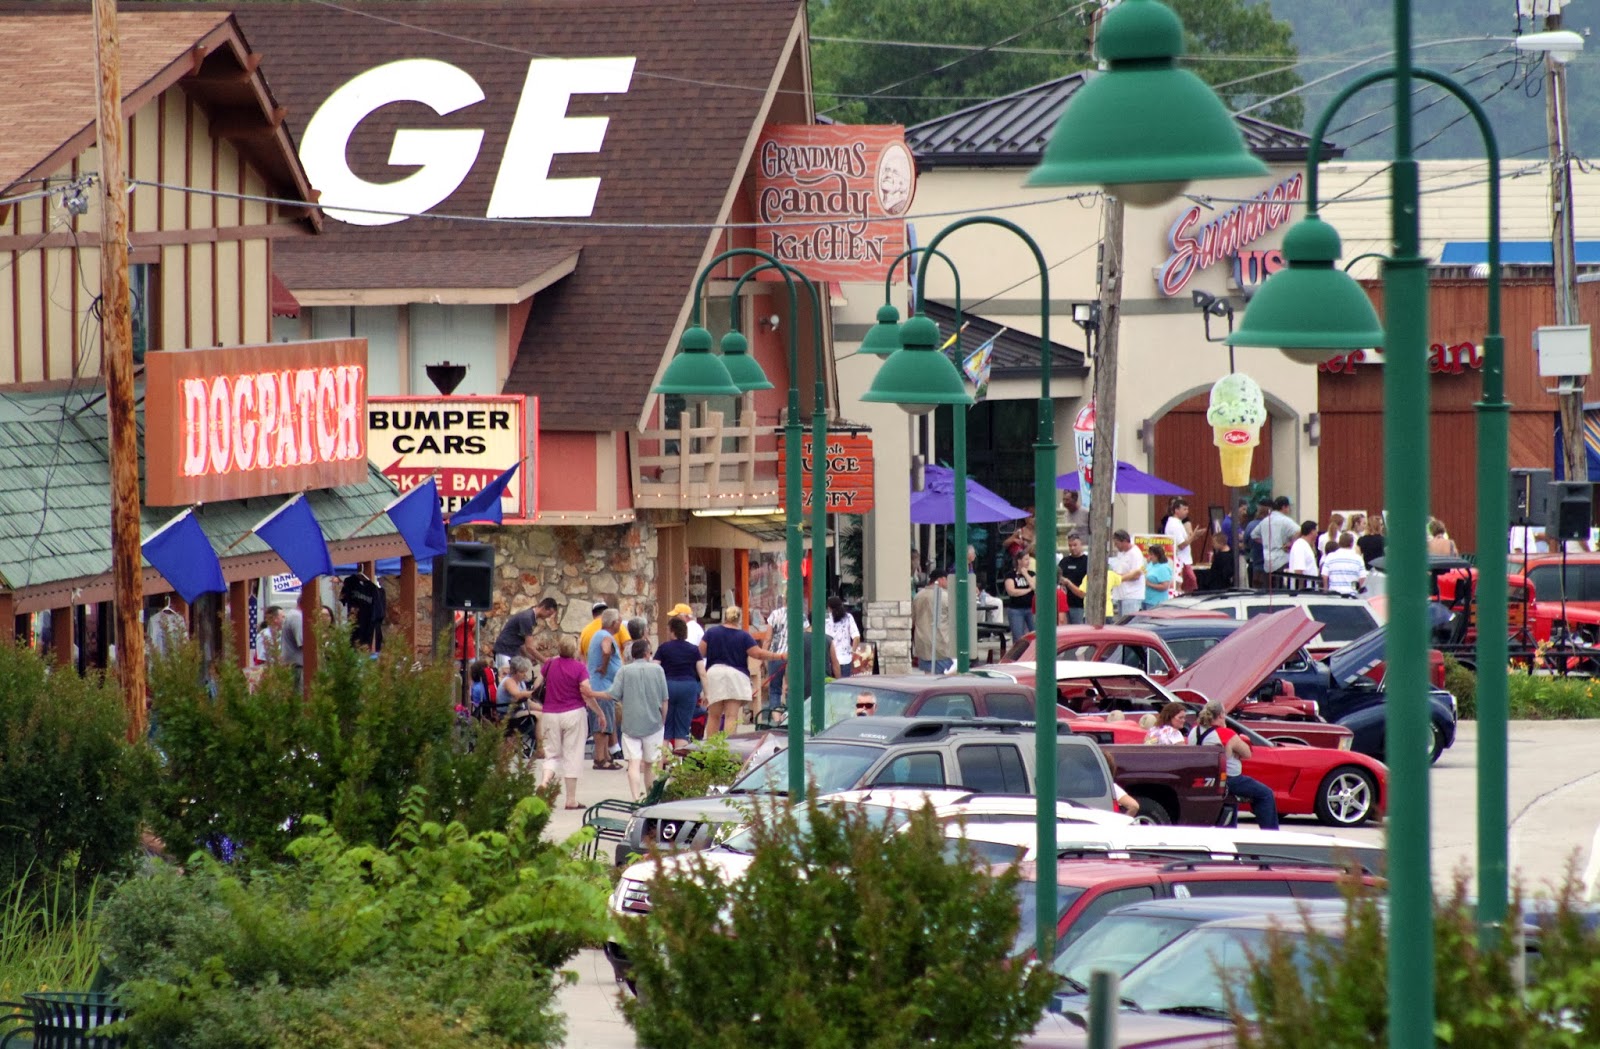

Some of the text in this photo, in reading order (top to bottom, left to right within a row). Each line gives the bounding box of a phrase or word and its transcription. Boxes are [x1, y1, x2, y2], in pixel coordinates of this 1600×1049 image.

[762, 142, 866, 178] GRANDMAS
[1160, 173, 1302, 296] Summer
[181, 365, 364, 477] DOGPATCH
[369, 411, 509, 430] BUMPER
[392, 435, 486, 454] CARS
